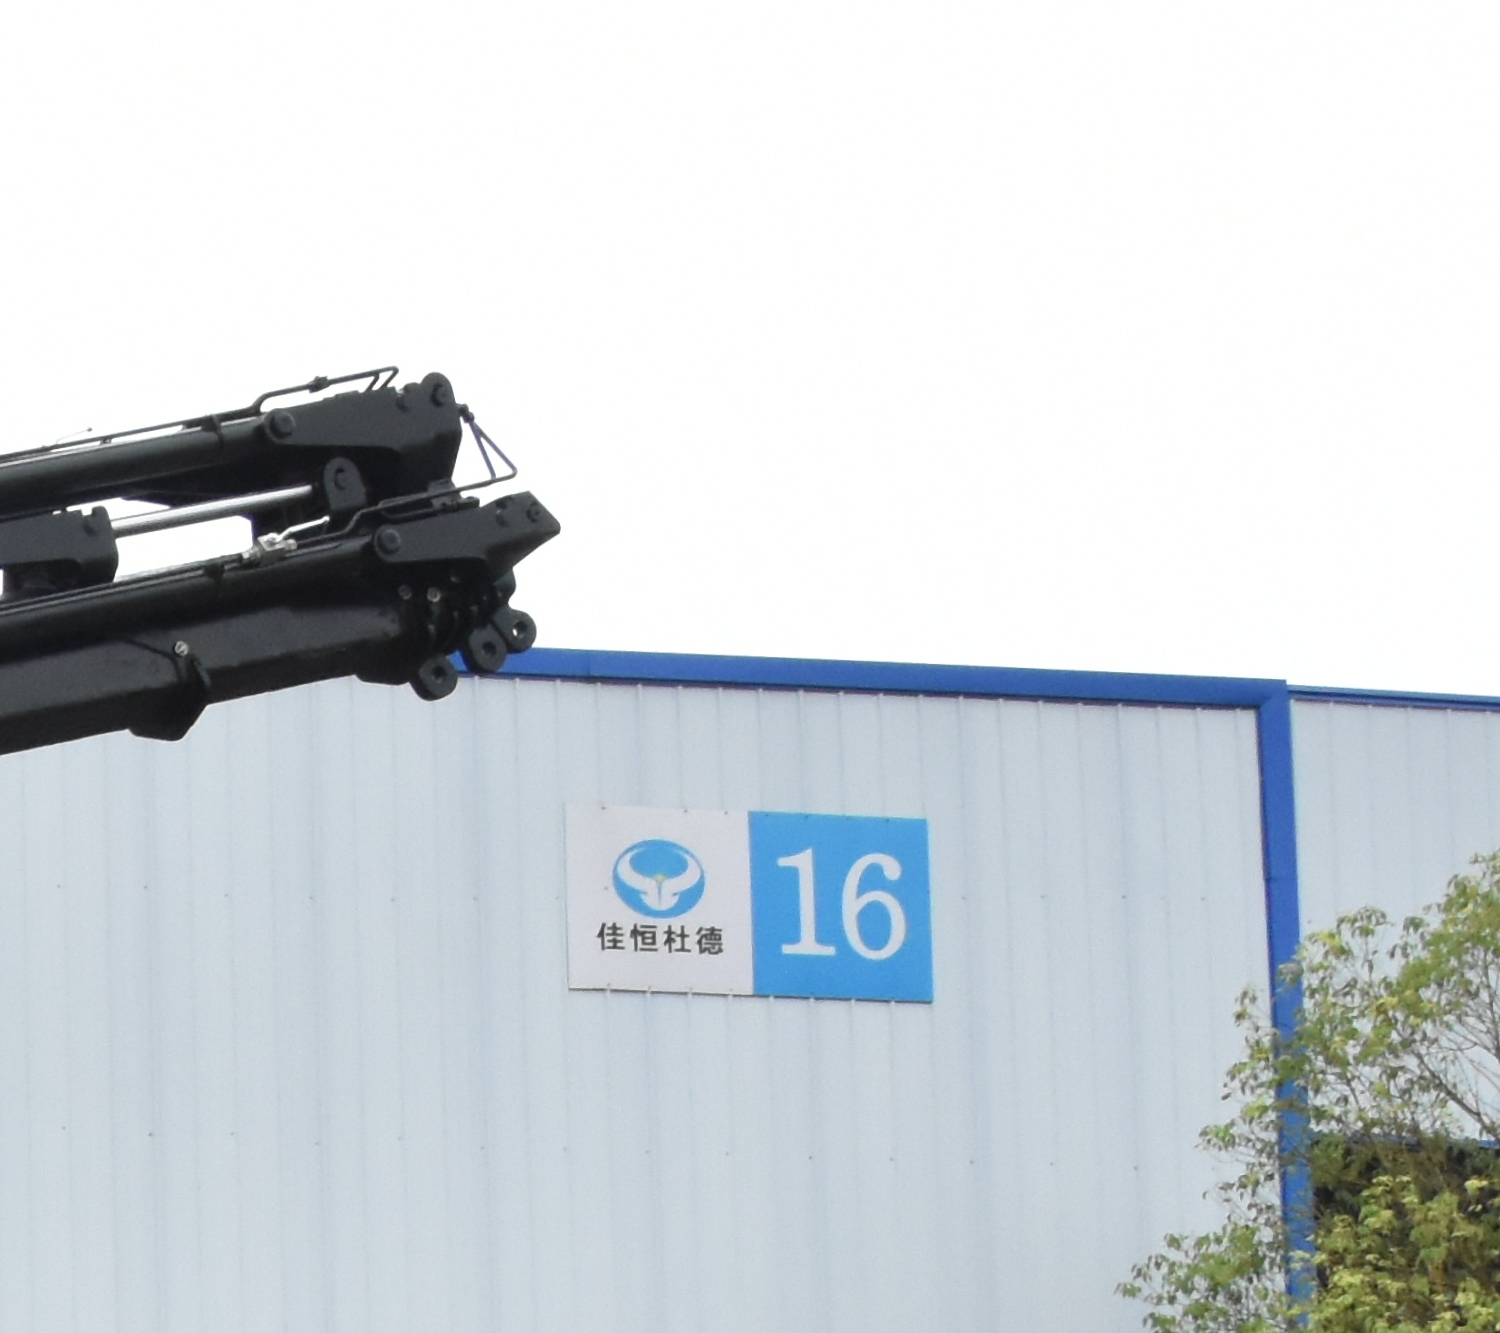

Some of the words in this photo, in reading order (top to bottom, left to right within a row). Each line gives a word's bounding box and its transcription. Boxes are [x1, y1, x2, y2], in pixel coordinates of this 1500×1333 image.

[596, 922, 725, 955] 佳恒杜德
[775, 845, 908, 962] 16
